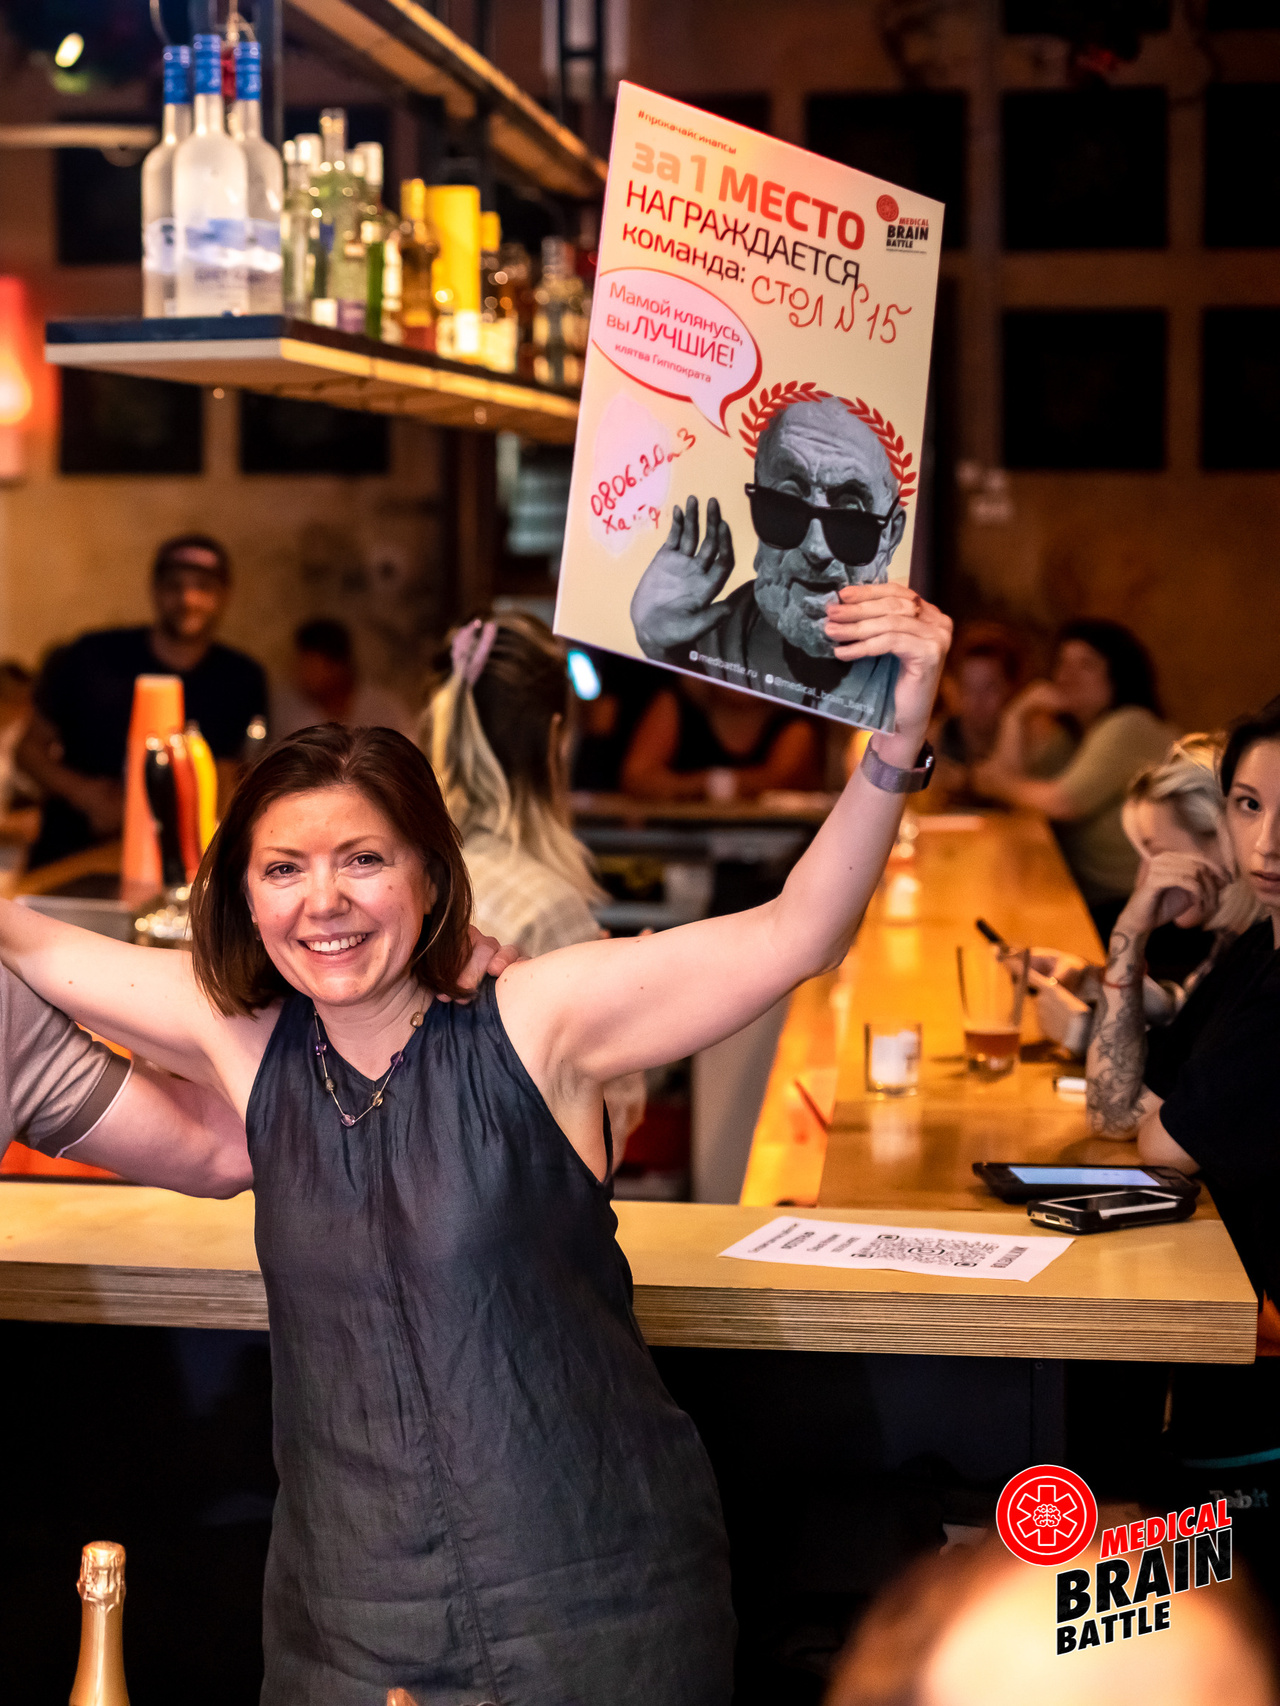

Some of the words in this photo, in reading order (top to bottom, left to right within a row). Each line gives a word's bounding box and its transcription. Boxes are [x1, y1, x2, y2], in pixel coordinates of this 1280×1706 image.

[638, 110, 737, 155] #прокачайсинапсы
[632, 142, 681, 185] за
[690, 154, 707, 194] 1
[718, 165, 865, 250] МЕСТО
[626, 180, 860, 290] НАГРАЖДАЕТСЯ
[886, 239, 913, 248] BATTLE
[887, 225, 929, 240] BRAIN
[899, 217, 929, 227] MEDICAL
[622, 223, 746, 283] команда:
[609, 282, 671, 318] Мамой
[674, 308, 743, 346] клянусь,
[606, 314, 630, 333] вы
[632, 315, 735, 368] ЛУЧШИЕ!
[615, 343, 650, 362] клятва
[652, 354, 712, 383] Гиппократа
